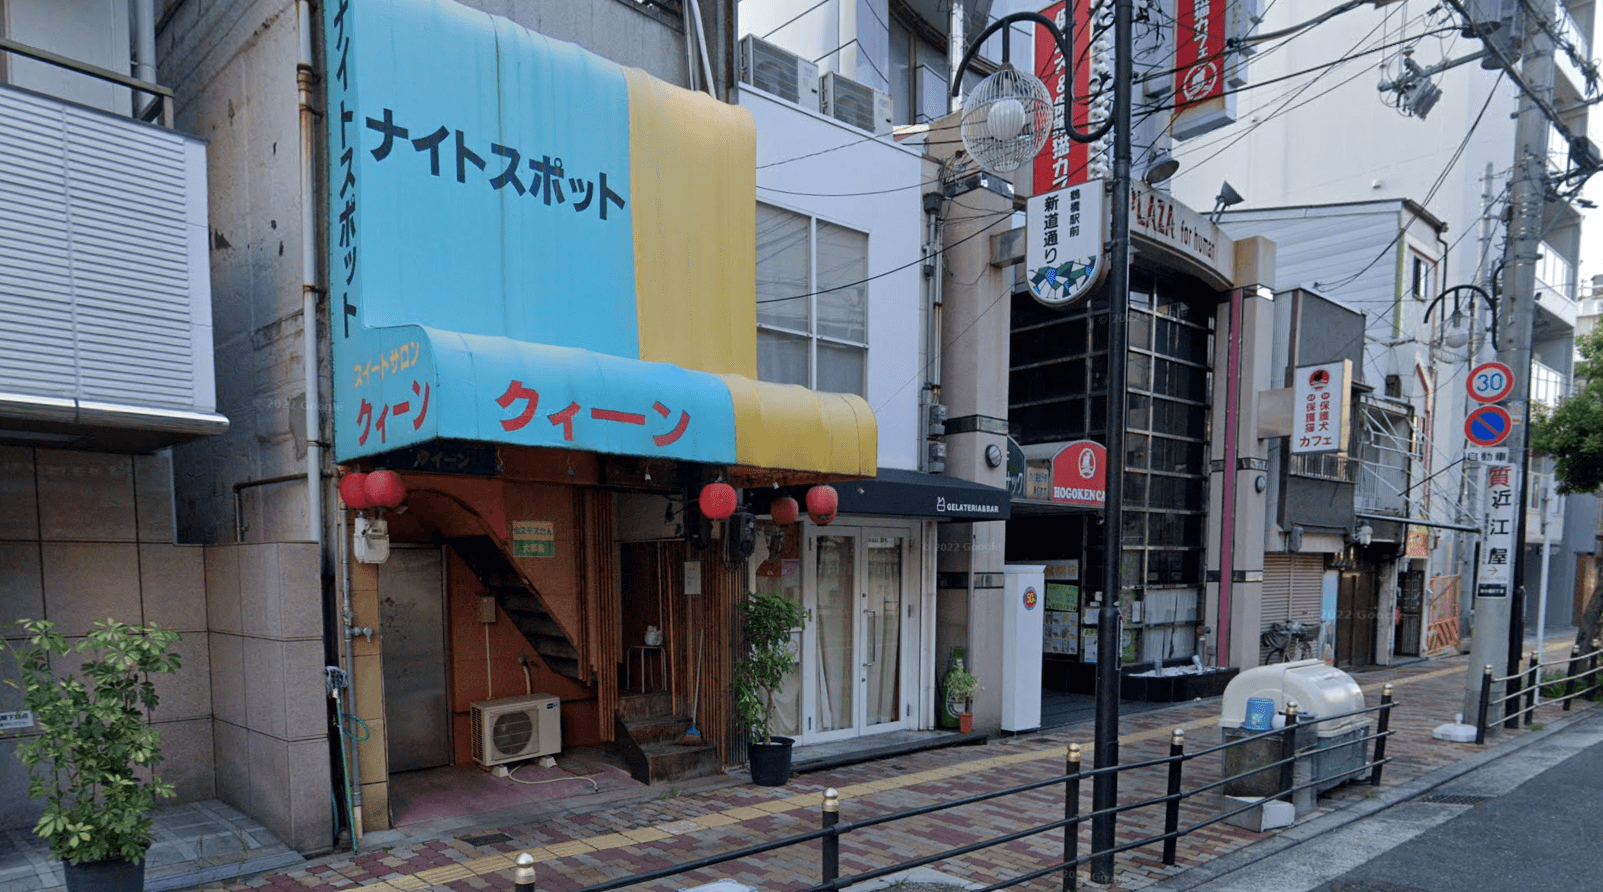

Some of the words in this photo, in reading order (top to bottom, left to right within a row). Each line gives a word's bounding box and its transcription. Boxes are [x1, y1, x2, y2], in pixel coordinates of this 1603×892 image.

[333, 0, 357, 339] ナイトスポット
[365, 107, 626, 221] ナイトスポット
[1043, 194, 1060, 265] 新道通り
[1181, 219, 1192, 247] for
[353, 341, 421, 389] スイートサロン
[1477, 372, 1504, 393] 30
[1299, 435, 1332, 448] カフェ
[1467, 451, 1507, 462] 自動車
[946, 502, 1000, 514] GELATERIA&BAR
